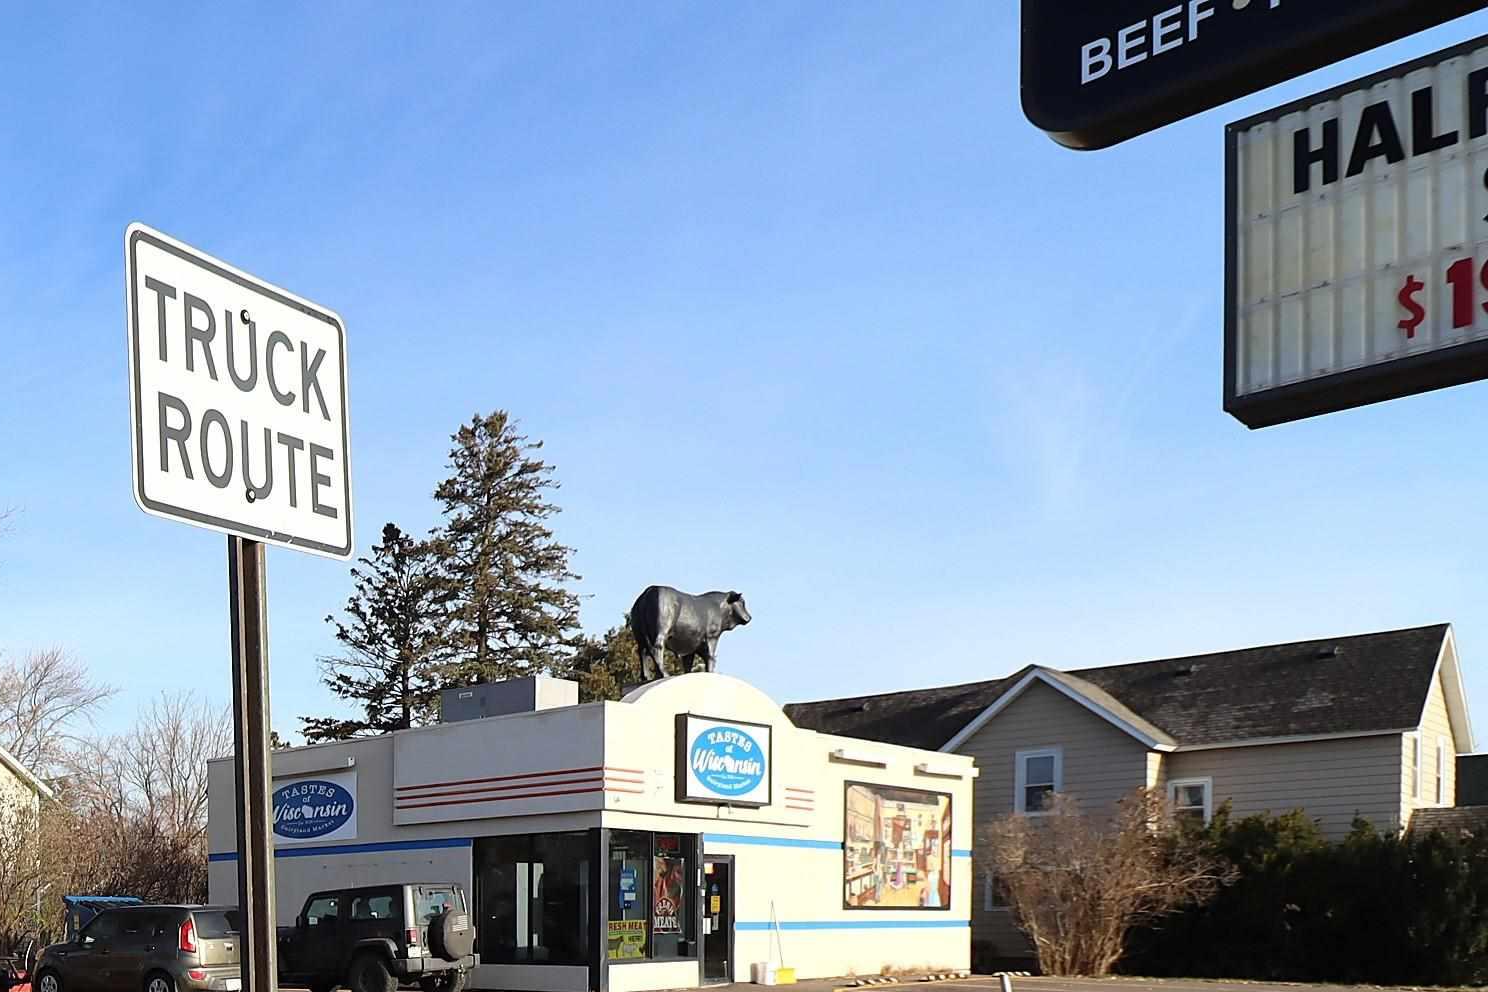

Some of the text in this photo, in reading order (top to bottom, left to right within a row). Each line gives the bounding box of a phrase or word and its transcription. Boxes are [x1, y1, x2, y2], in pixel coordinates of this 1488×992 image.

[1081, 0, 1215, 85] BEEF
[1398, 257, 1488, 339] $1
[145, 275, 331, 422] TRUCK
[158, 391, 338, 519] ROUTE
[707, 730, 753, 753] TASTES
[281, 784, 336, 800] TASTES
[302, 795, 312, 803] of
[608, 922, 627, 931] RESH
